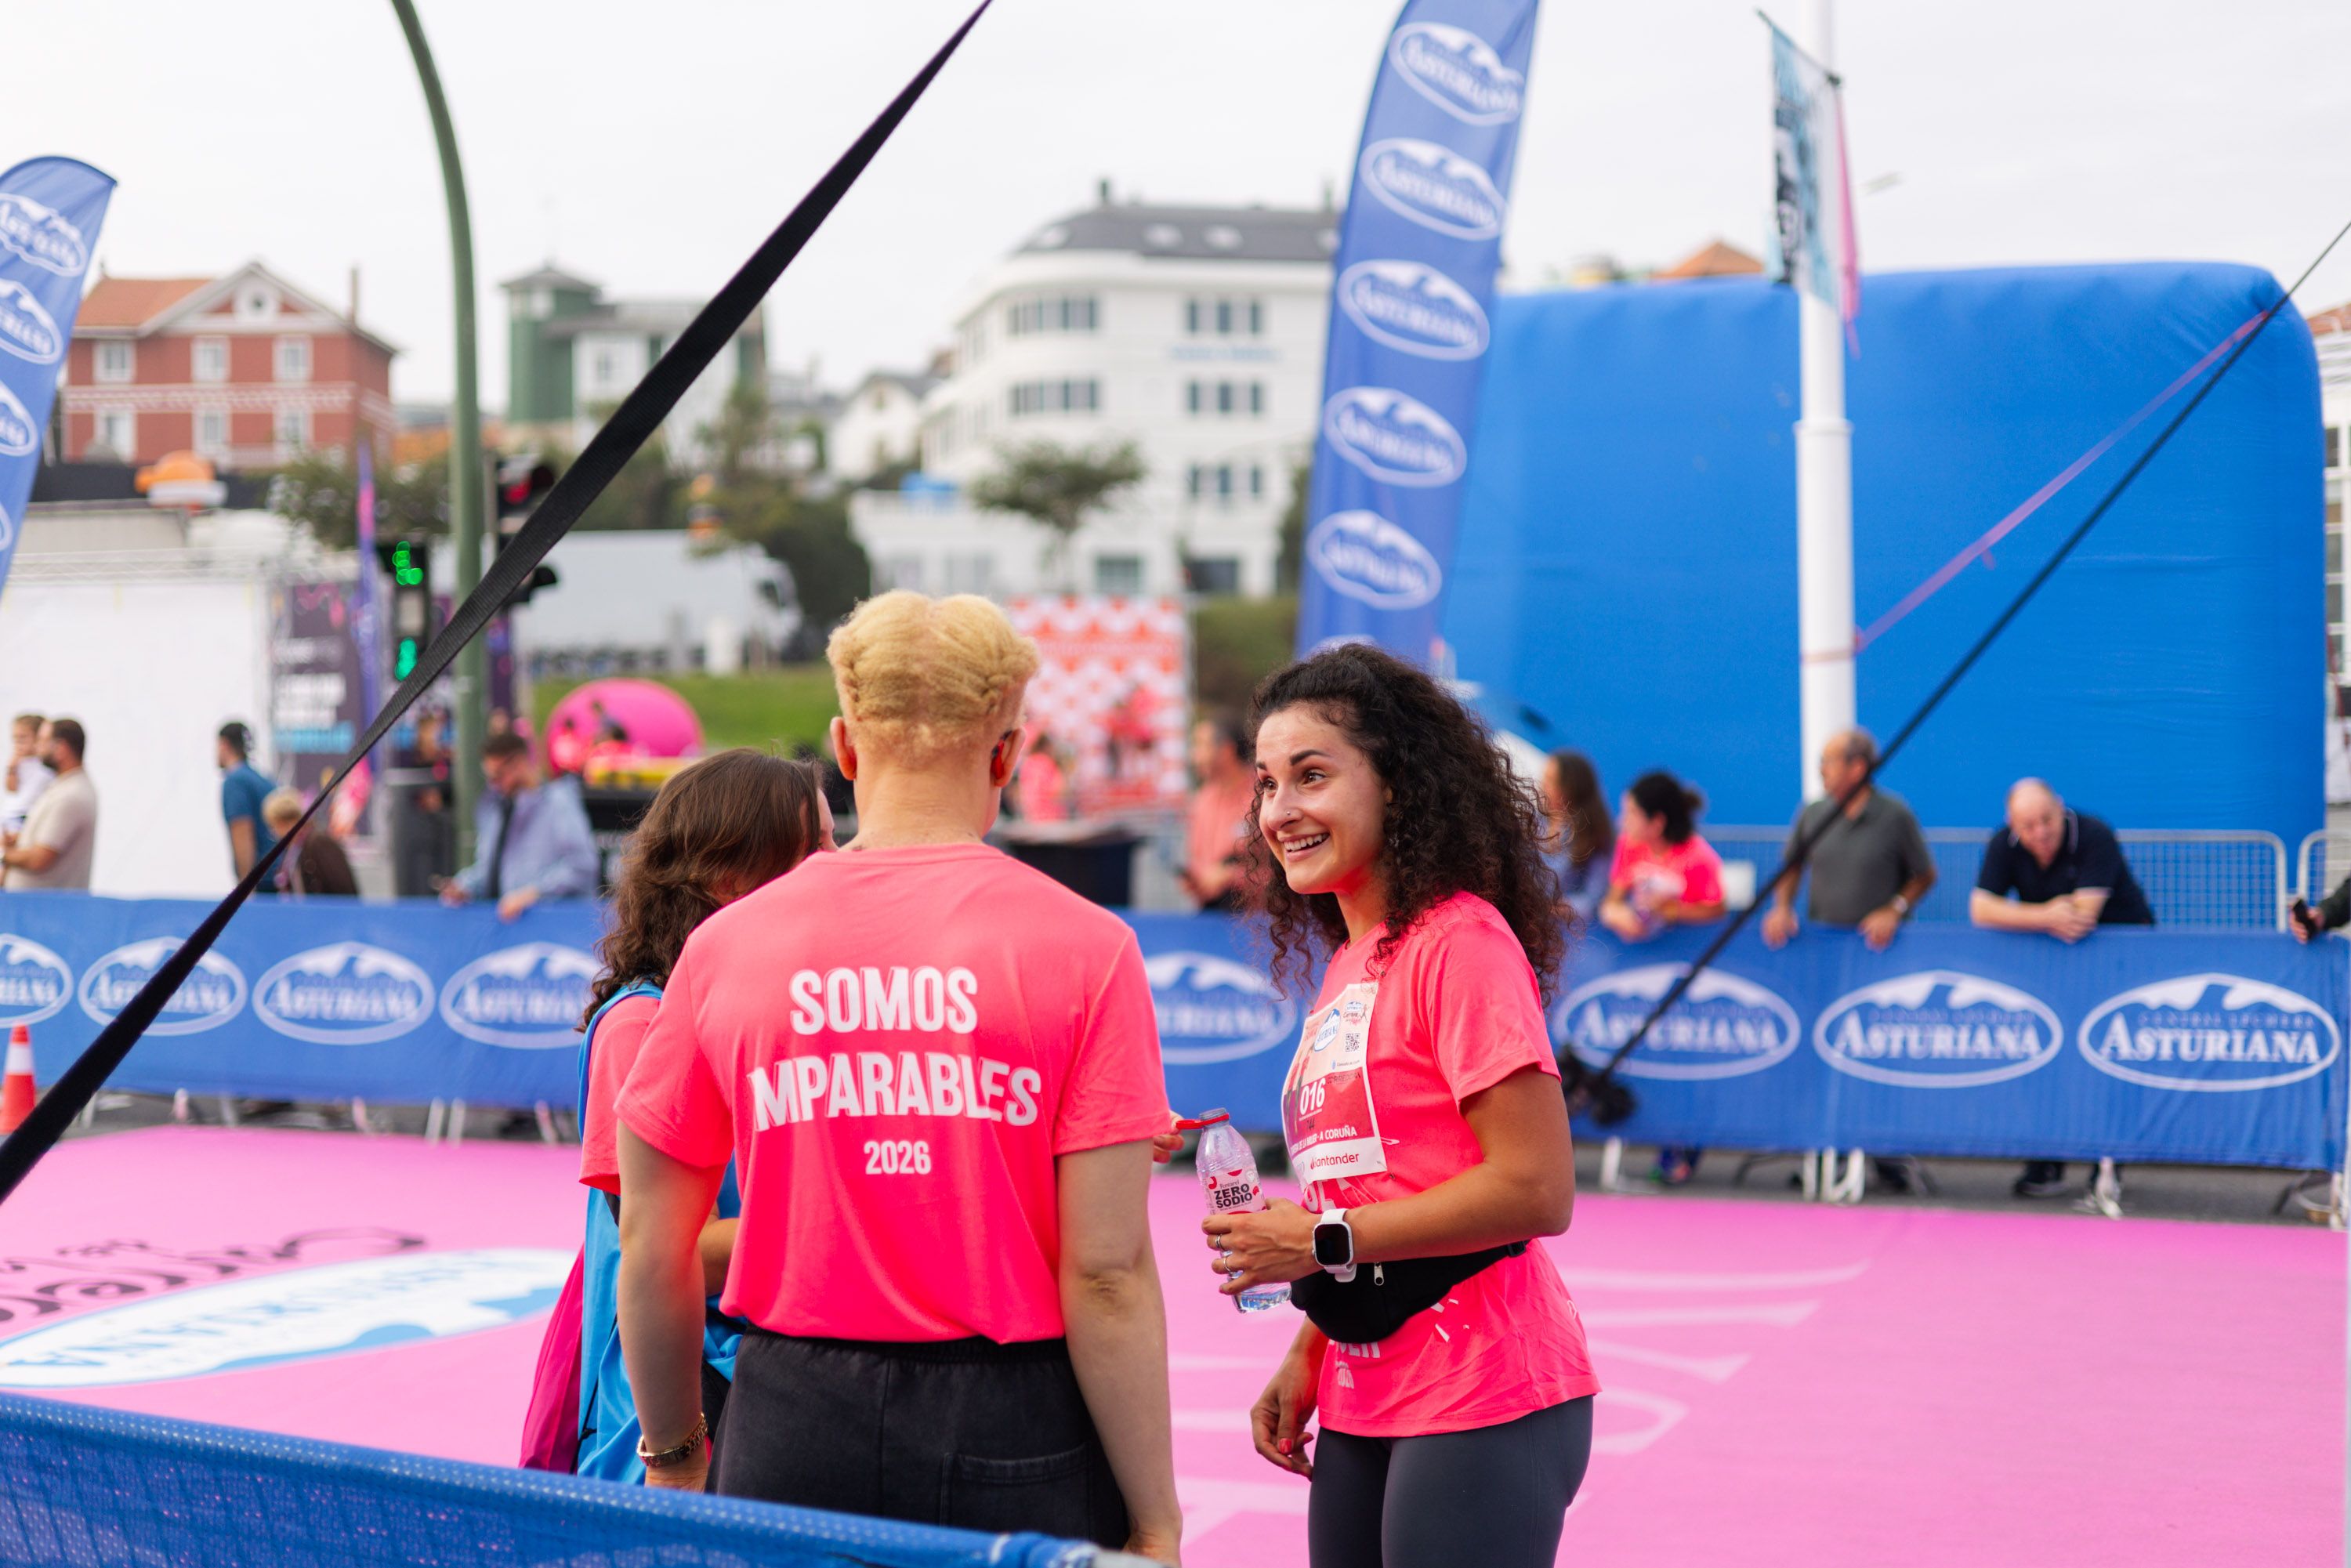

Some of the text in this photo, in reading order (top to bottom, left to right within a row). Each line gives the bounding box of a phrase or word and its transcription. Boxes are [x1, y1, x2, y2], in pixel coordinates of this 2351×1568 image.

[790, 966, 977, 1035] SOMOS
[1835, 1009, 2041, 1059] ASTURIANA
[2100, 1013, 2321, 1063] ASTURIANA
[1324, 1125, 1357, 1140] CORUÑA
[864, 1140, 932, 1175] 2026
[1214, 1183, 1250, 1200] ZERO
[1216, 1193, 1252, 1208] SODIO
